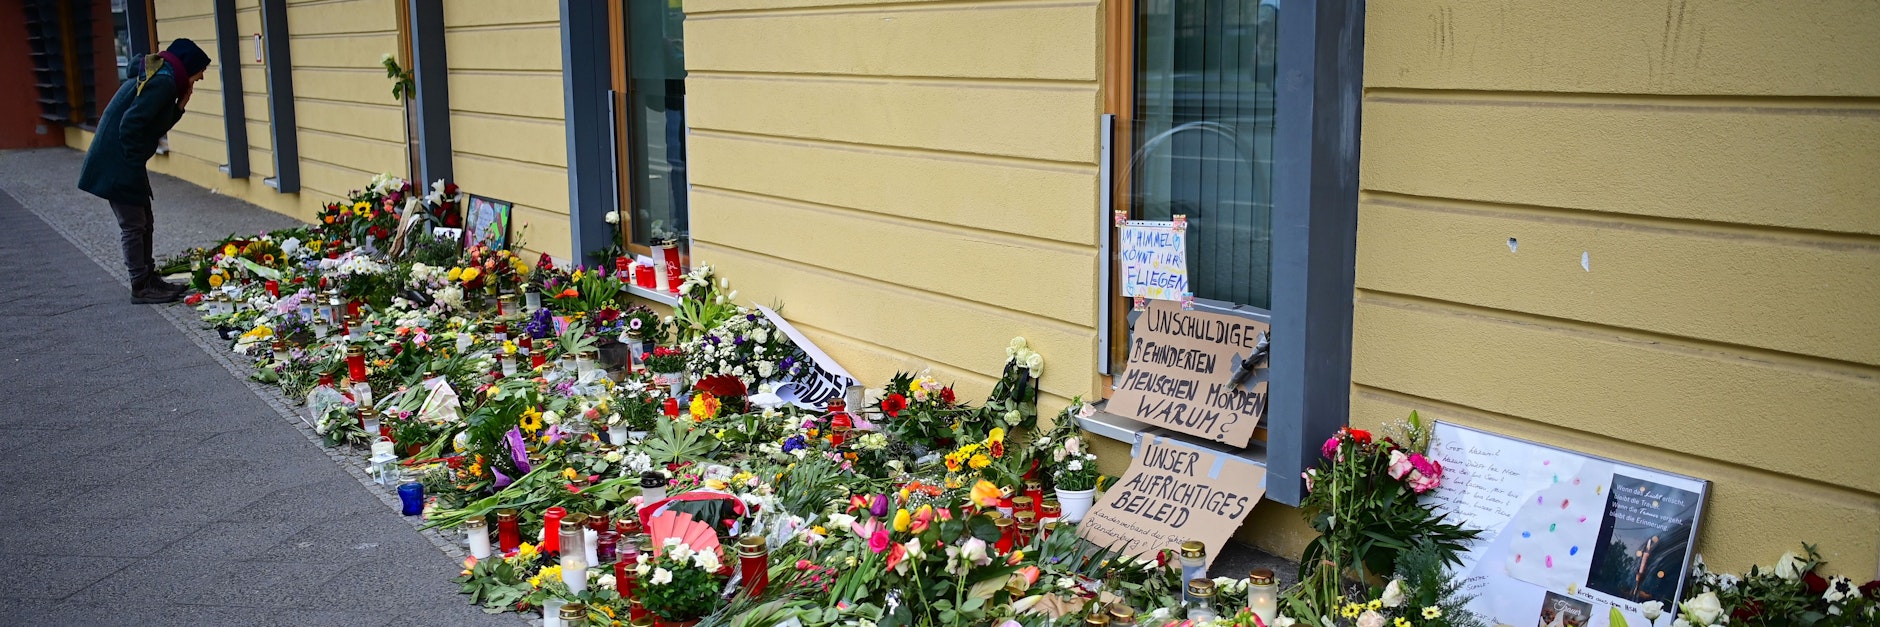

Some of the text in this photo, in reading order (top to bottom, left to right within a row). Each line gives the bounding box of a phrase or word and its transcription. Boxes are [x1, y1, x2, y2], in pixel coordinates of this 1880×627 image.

[1122, 228, 1173, 248] IM HIMMEL
[1122, 246, 1180, 268] KÖNNT IHR
[1127, 266, 1188, 292] FLIEGEN
[1147, 306, 1255, 348] UNSCHULDIGE
[1130, 337, 1217, 374] BEHINDERTEN
[1121, 368, 1200, 401] MENSCHEN
[1143, 444, 1200, 477] UNSER
[1124, 472, 1249, 520] AUFRICHTIGES
[1614, 492, 1630, 503] bleibt
[1630, 497, 1640, 505] die
[1616, 484, 1633, 494] Wenn
[1110, 490, 1190, 529] BEILEID
[1611, 501, 1630, 511] Wenn
[1628, 504, 1638, 513] die
[1609, 510, 1669, 532] bleibt die Erinnerung.
